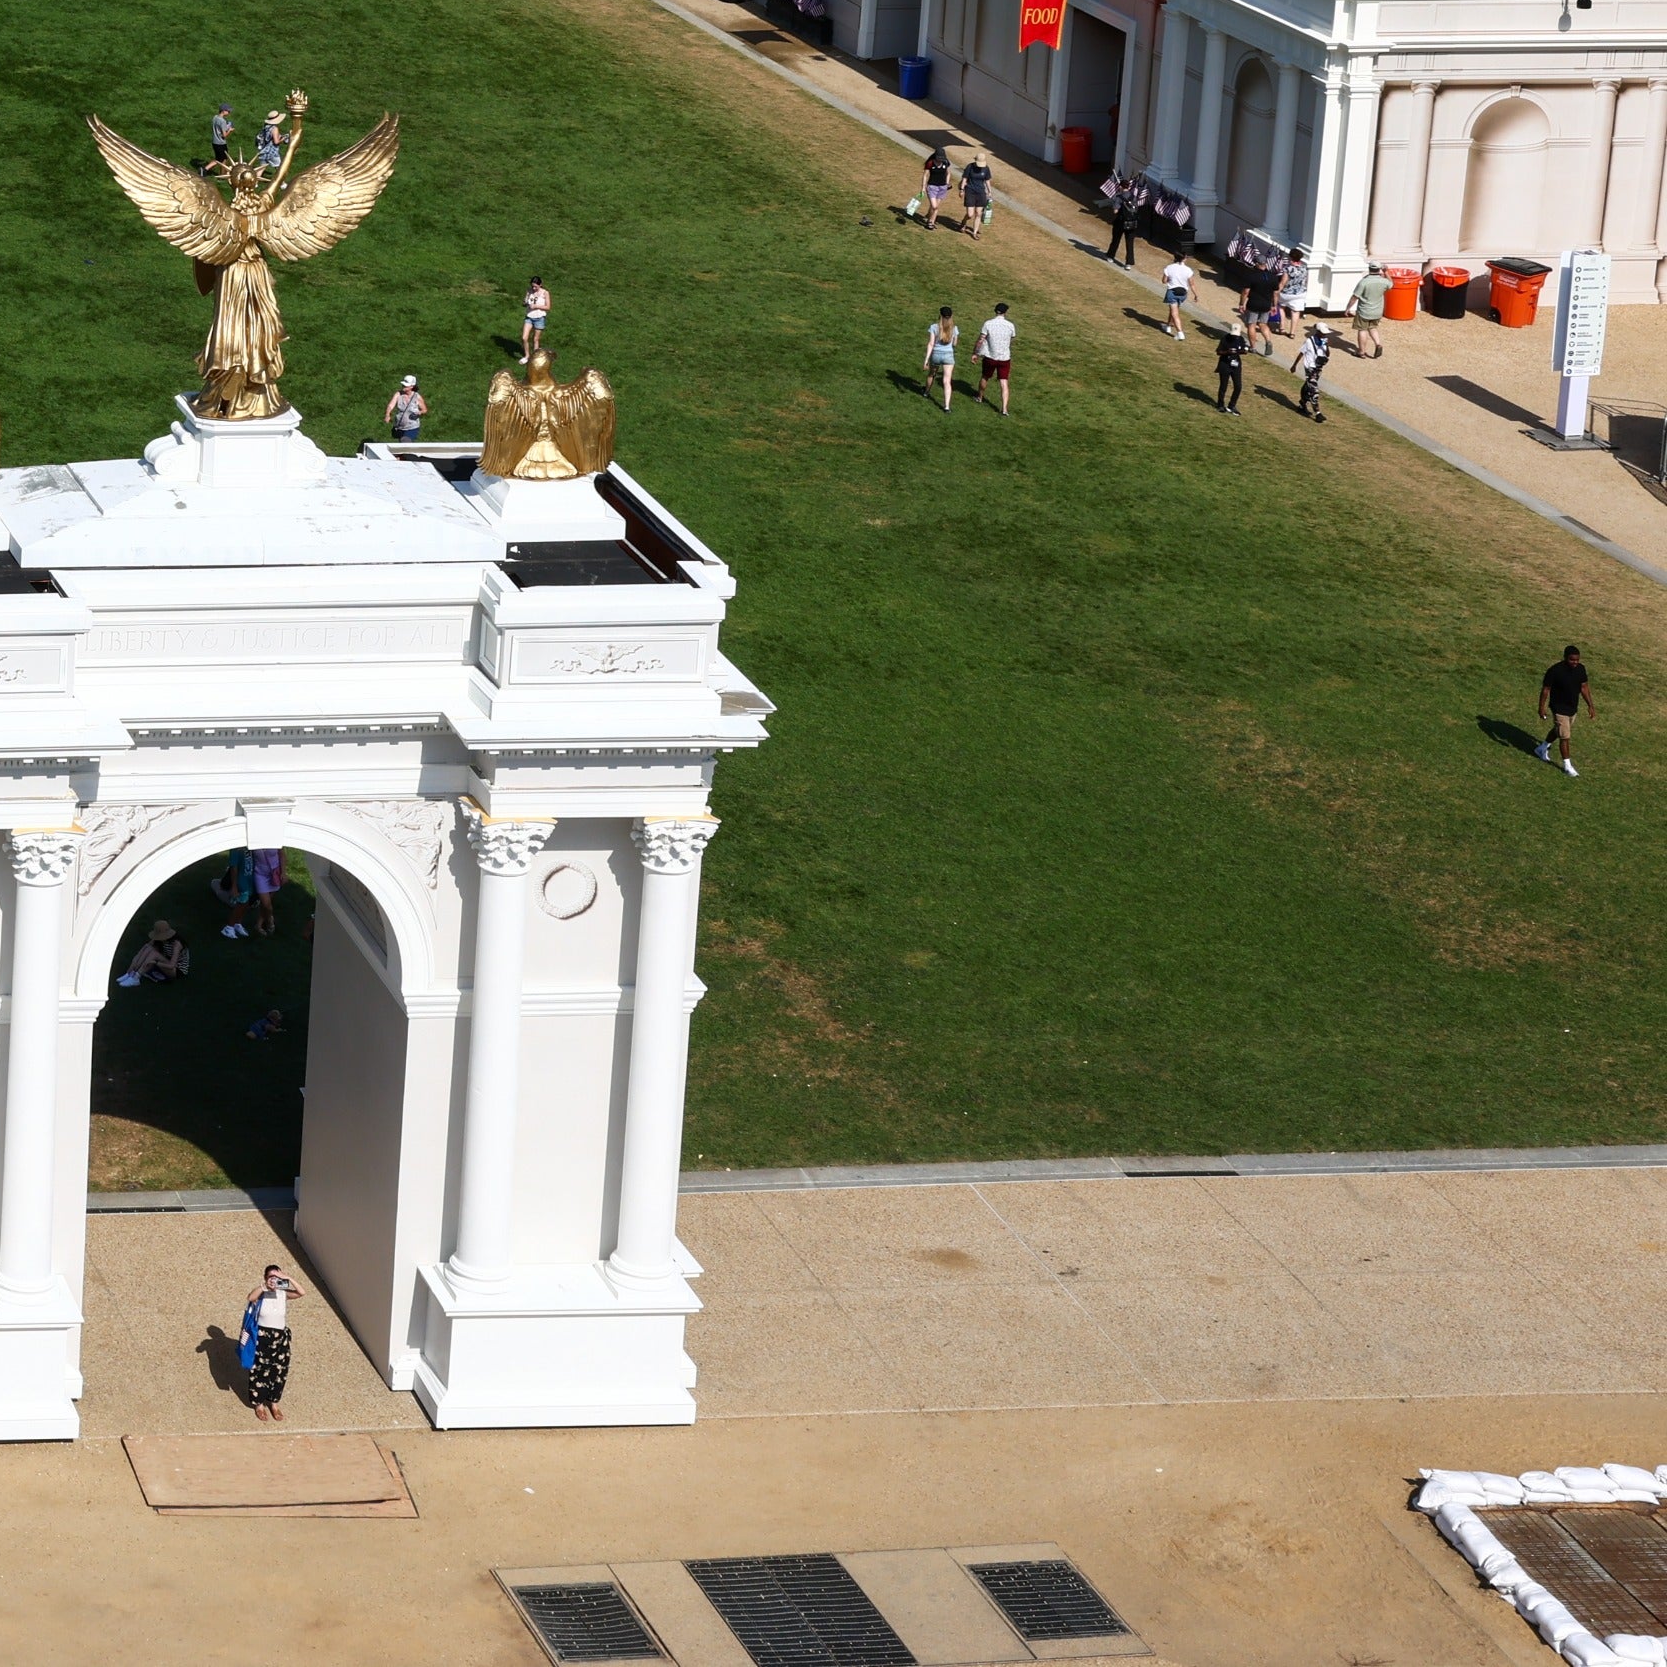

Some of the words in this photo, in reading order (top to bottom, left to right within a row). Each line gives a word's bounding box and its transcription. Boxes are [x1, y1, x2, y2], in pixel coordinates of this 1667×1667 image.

[1023, 8, 1059, 25] FOOD
[85, 629, 193, 652] LIBERTY
[229, 627, 335, 650] JUSTICE
[347, 626, 395, 647] FOR
[410, 625, 457, 646] ALL
